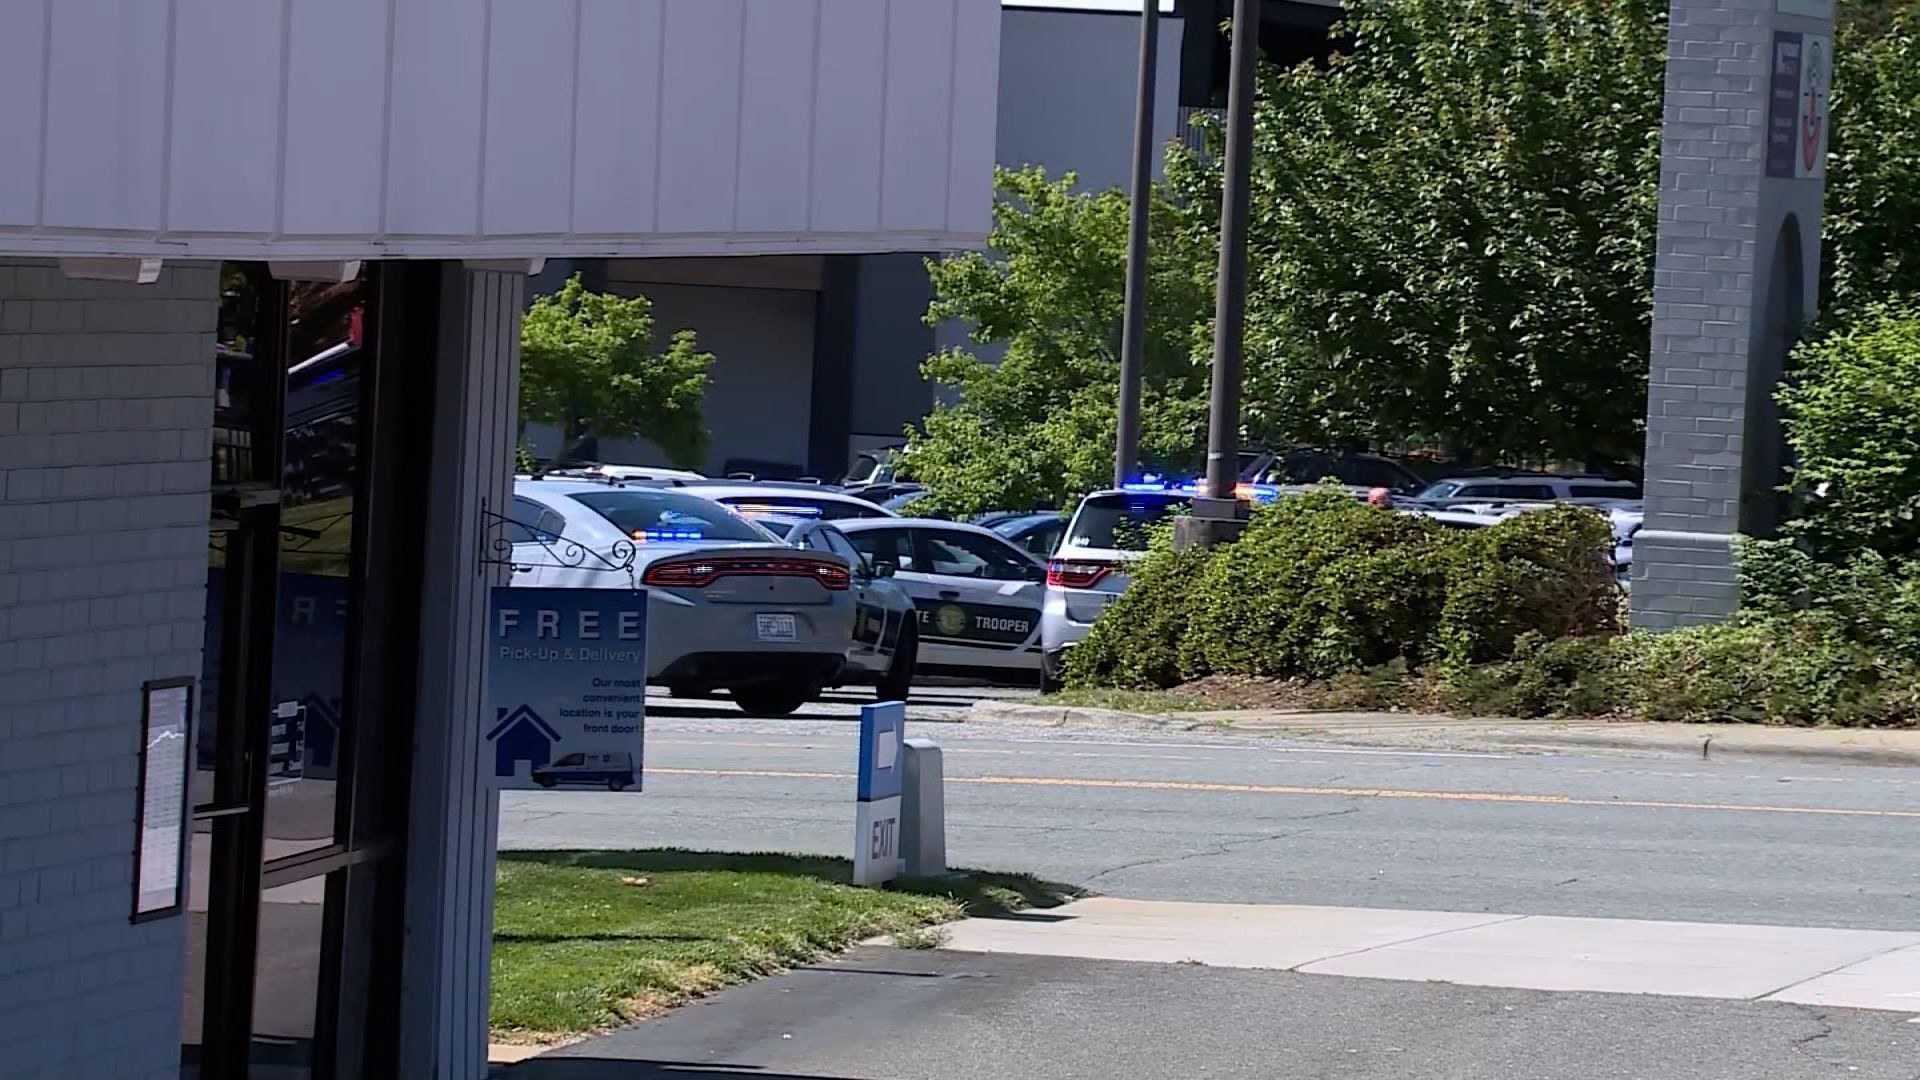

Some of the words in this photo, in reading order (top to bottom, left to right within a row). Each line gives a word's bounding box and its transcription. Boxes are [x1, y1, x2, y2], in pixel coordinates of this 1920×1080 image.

[499, 608, 641, 639] FREE
[975, 615, 1029, 632] TROOPER
[500, 647, 558, 663] Pick-Up
[564, 648, 575, 660] &
[579, 648, 640, 663] Delivery
[592, 677, 611, 688] Our
[614, 677, 641, 688] most
[582, 693, 641, 704] convenient
[559, 708, 601, 718] location
[603, 708, 613, 718] is
[616, 710, 640, 721] your
[584, 723, 608, 734] front
[611, 723, 640, 734] door!
[871, 817, 896, 860] EXIT
